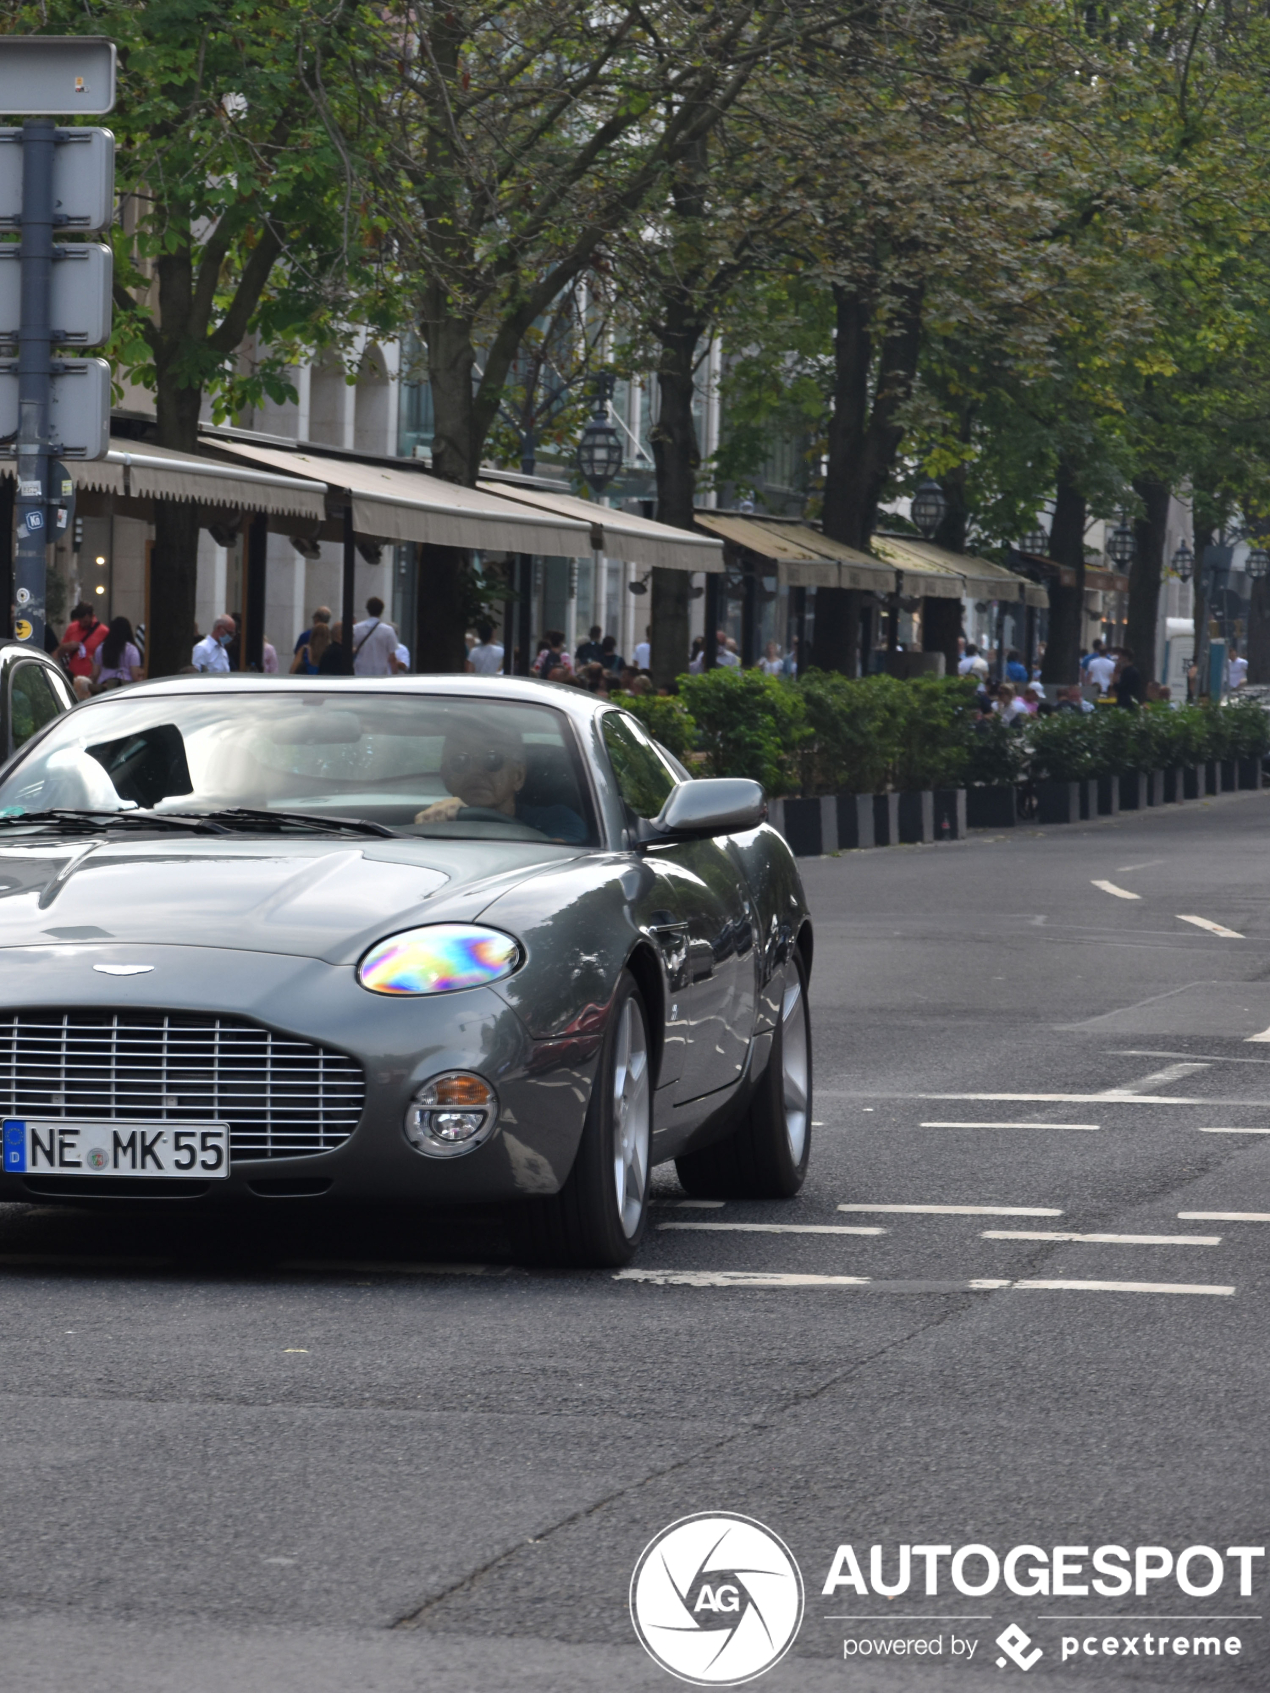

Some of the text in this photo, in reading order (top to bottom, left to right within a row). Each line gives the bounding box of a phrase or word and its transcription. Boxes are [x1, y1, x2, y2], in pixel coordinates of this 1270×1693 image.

[9, 1128, 224, 1171] D NE MK 55
